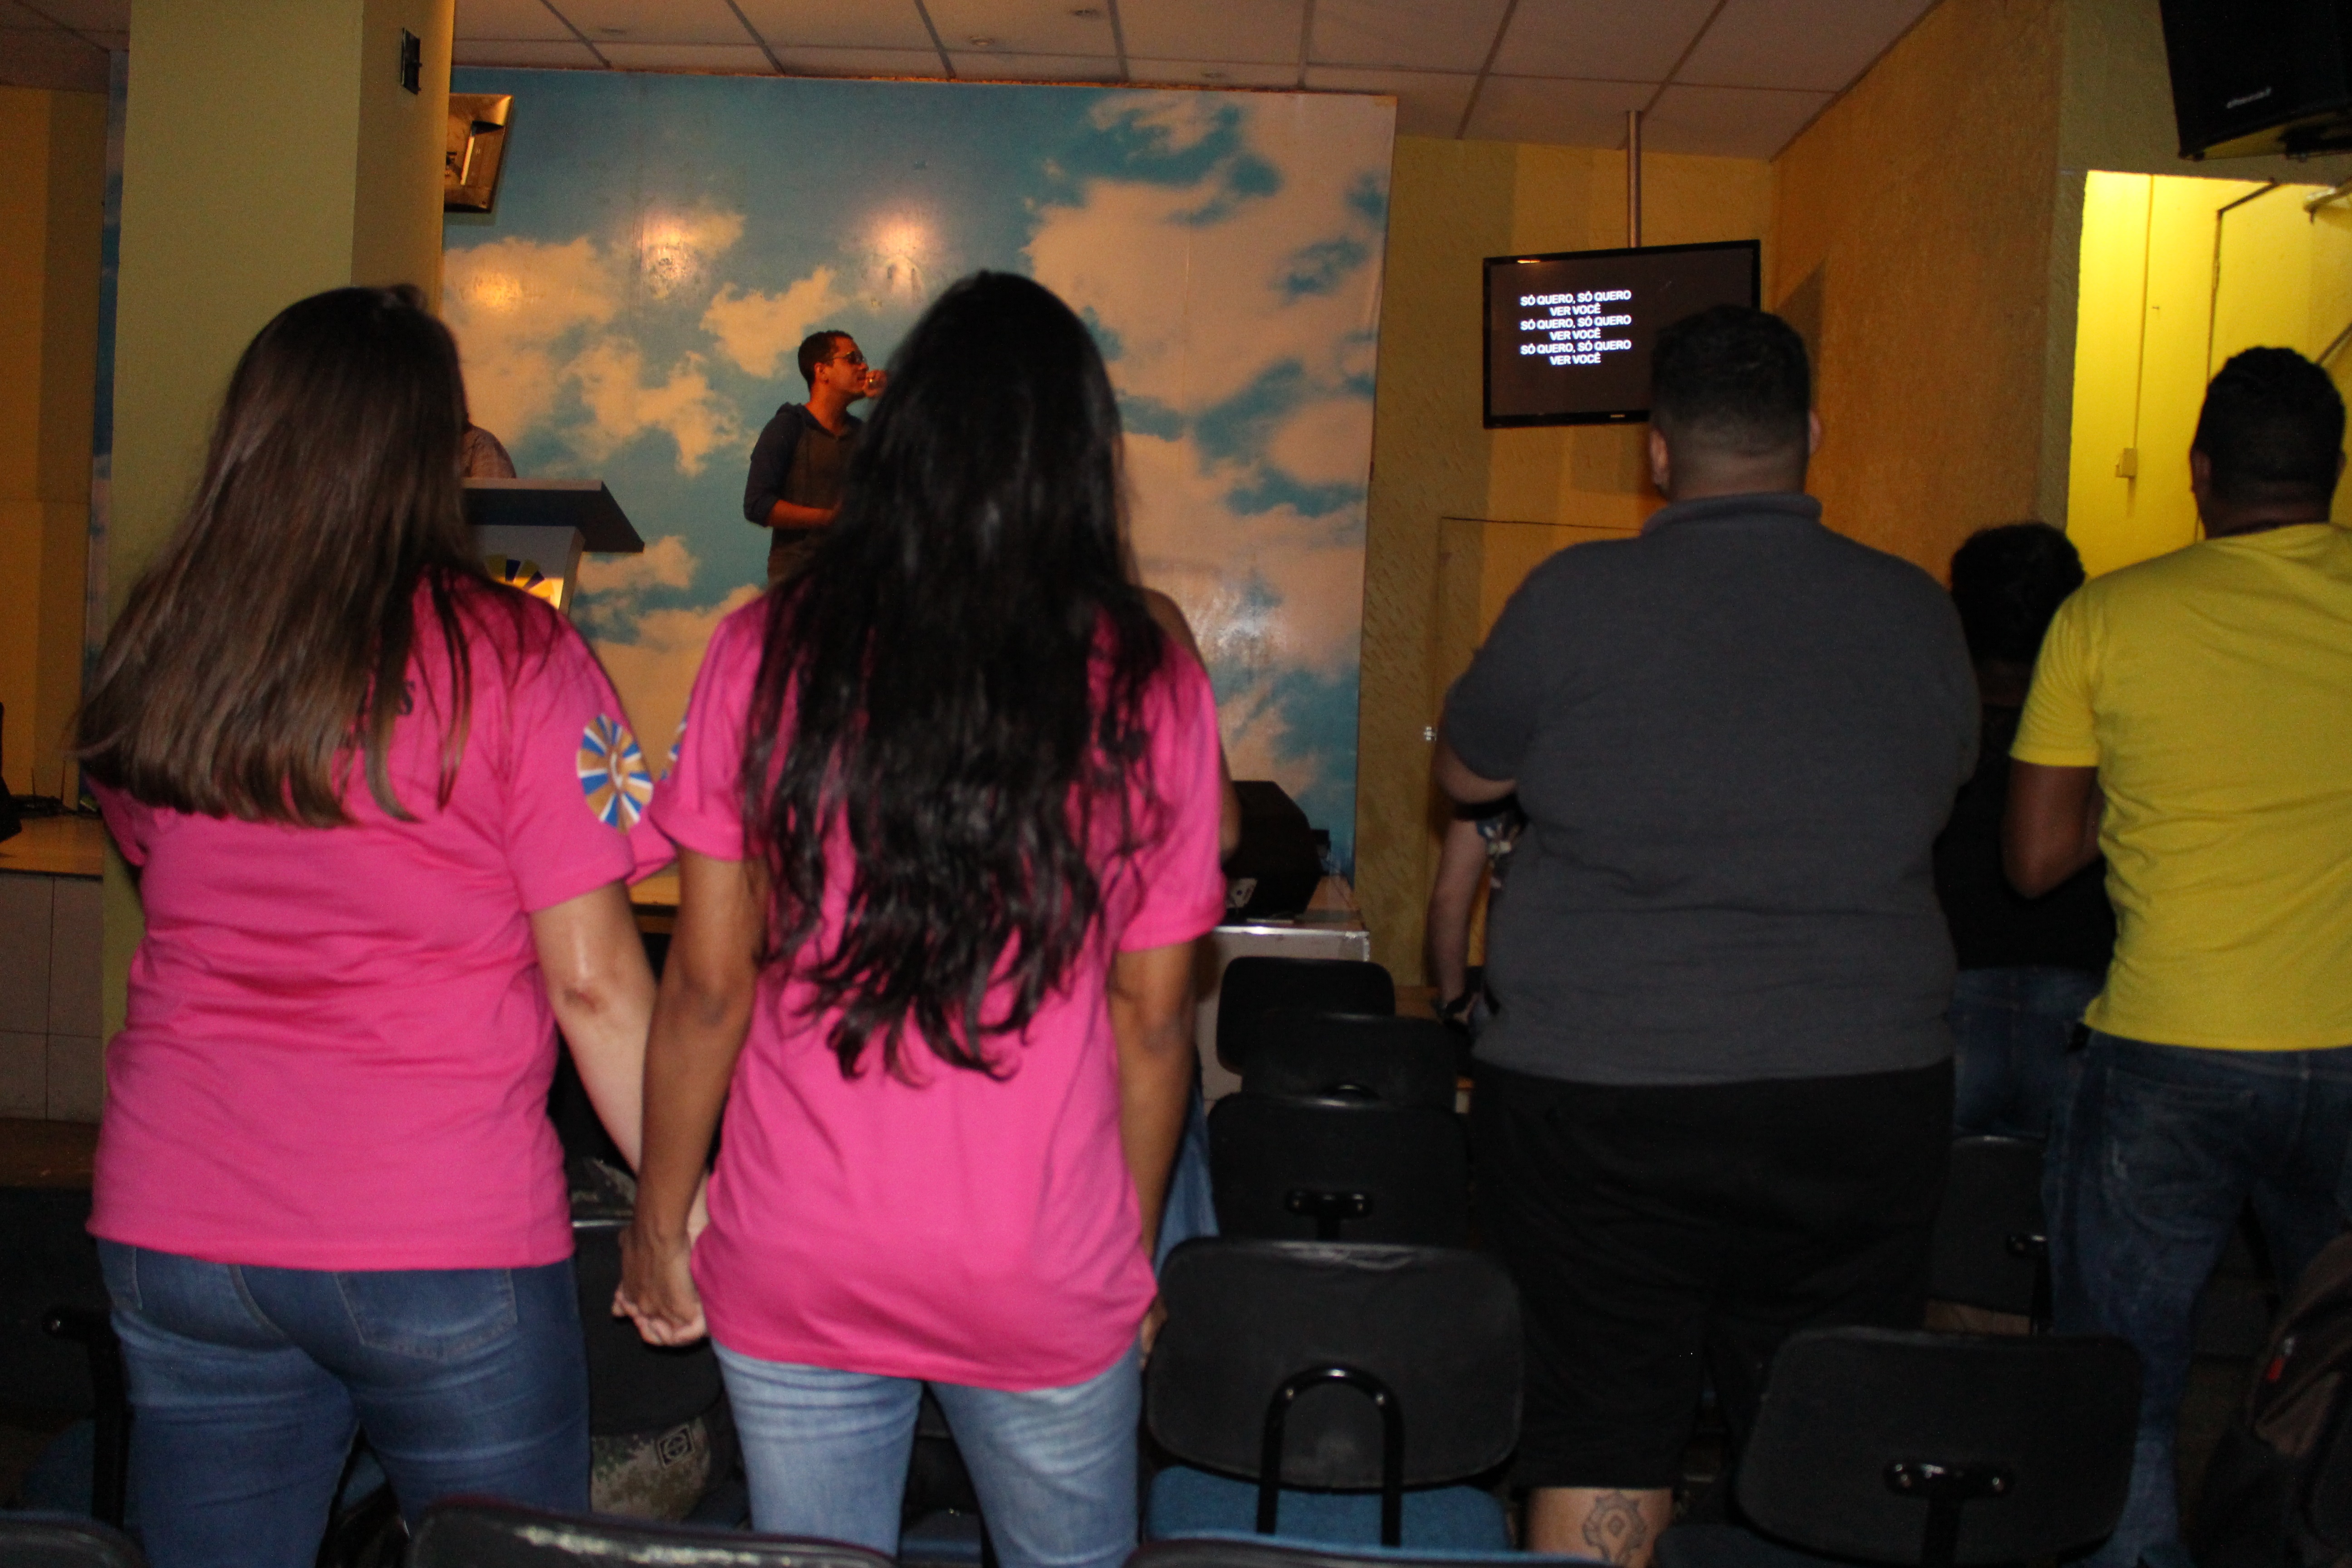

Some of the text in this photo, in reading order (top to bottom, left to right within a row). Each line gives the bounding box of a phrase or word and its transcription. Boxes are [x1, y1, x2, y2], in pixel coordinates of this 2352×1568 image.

[1520, 290, 1632, 306] SÓ QUERO, SÓ QUERO
[1549, 303, 1601, 316] VER VOCÊ
[1520, 314, 1632, 330] SÓ QUERO, SÓ QUERO
[1549, 327, 1601, 341] VER VOCÊ
[1520, 339, 1632, 355] SÓ QUERO, SÓ QUERO
[1549, 352, 1601, 365] VER VOCÊ
